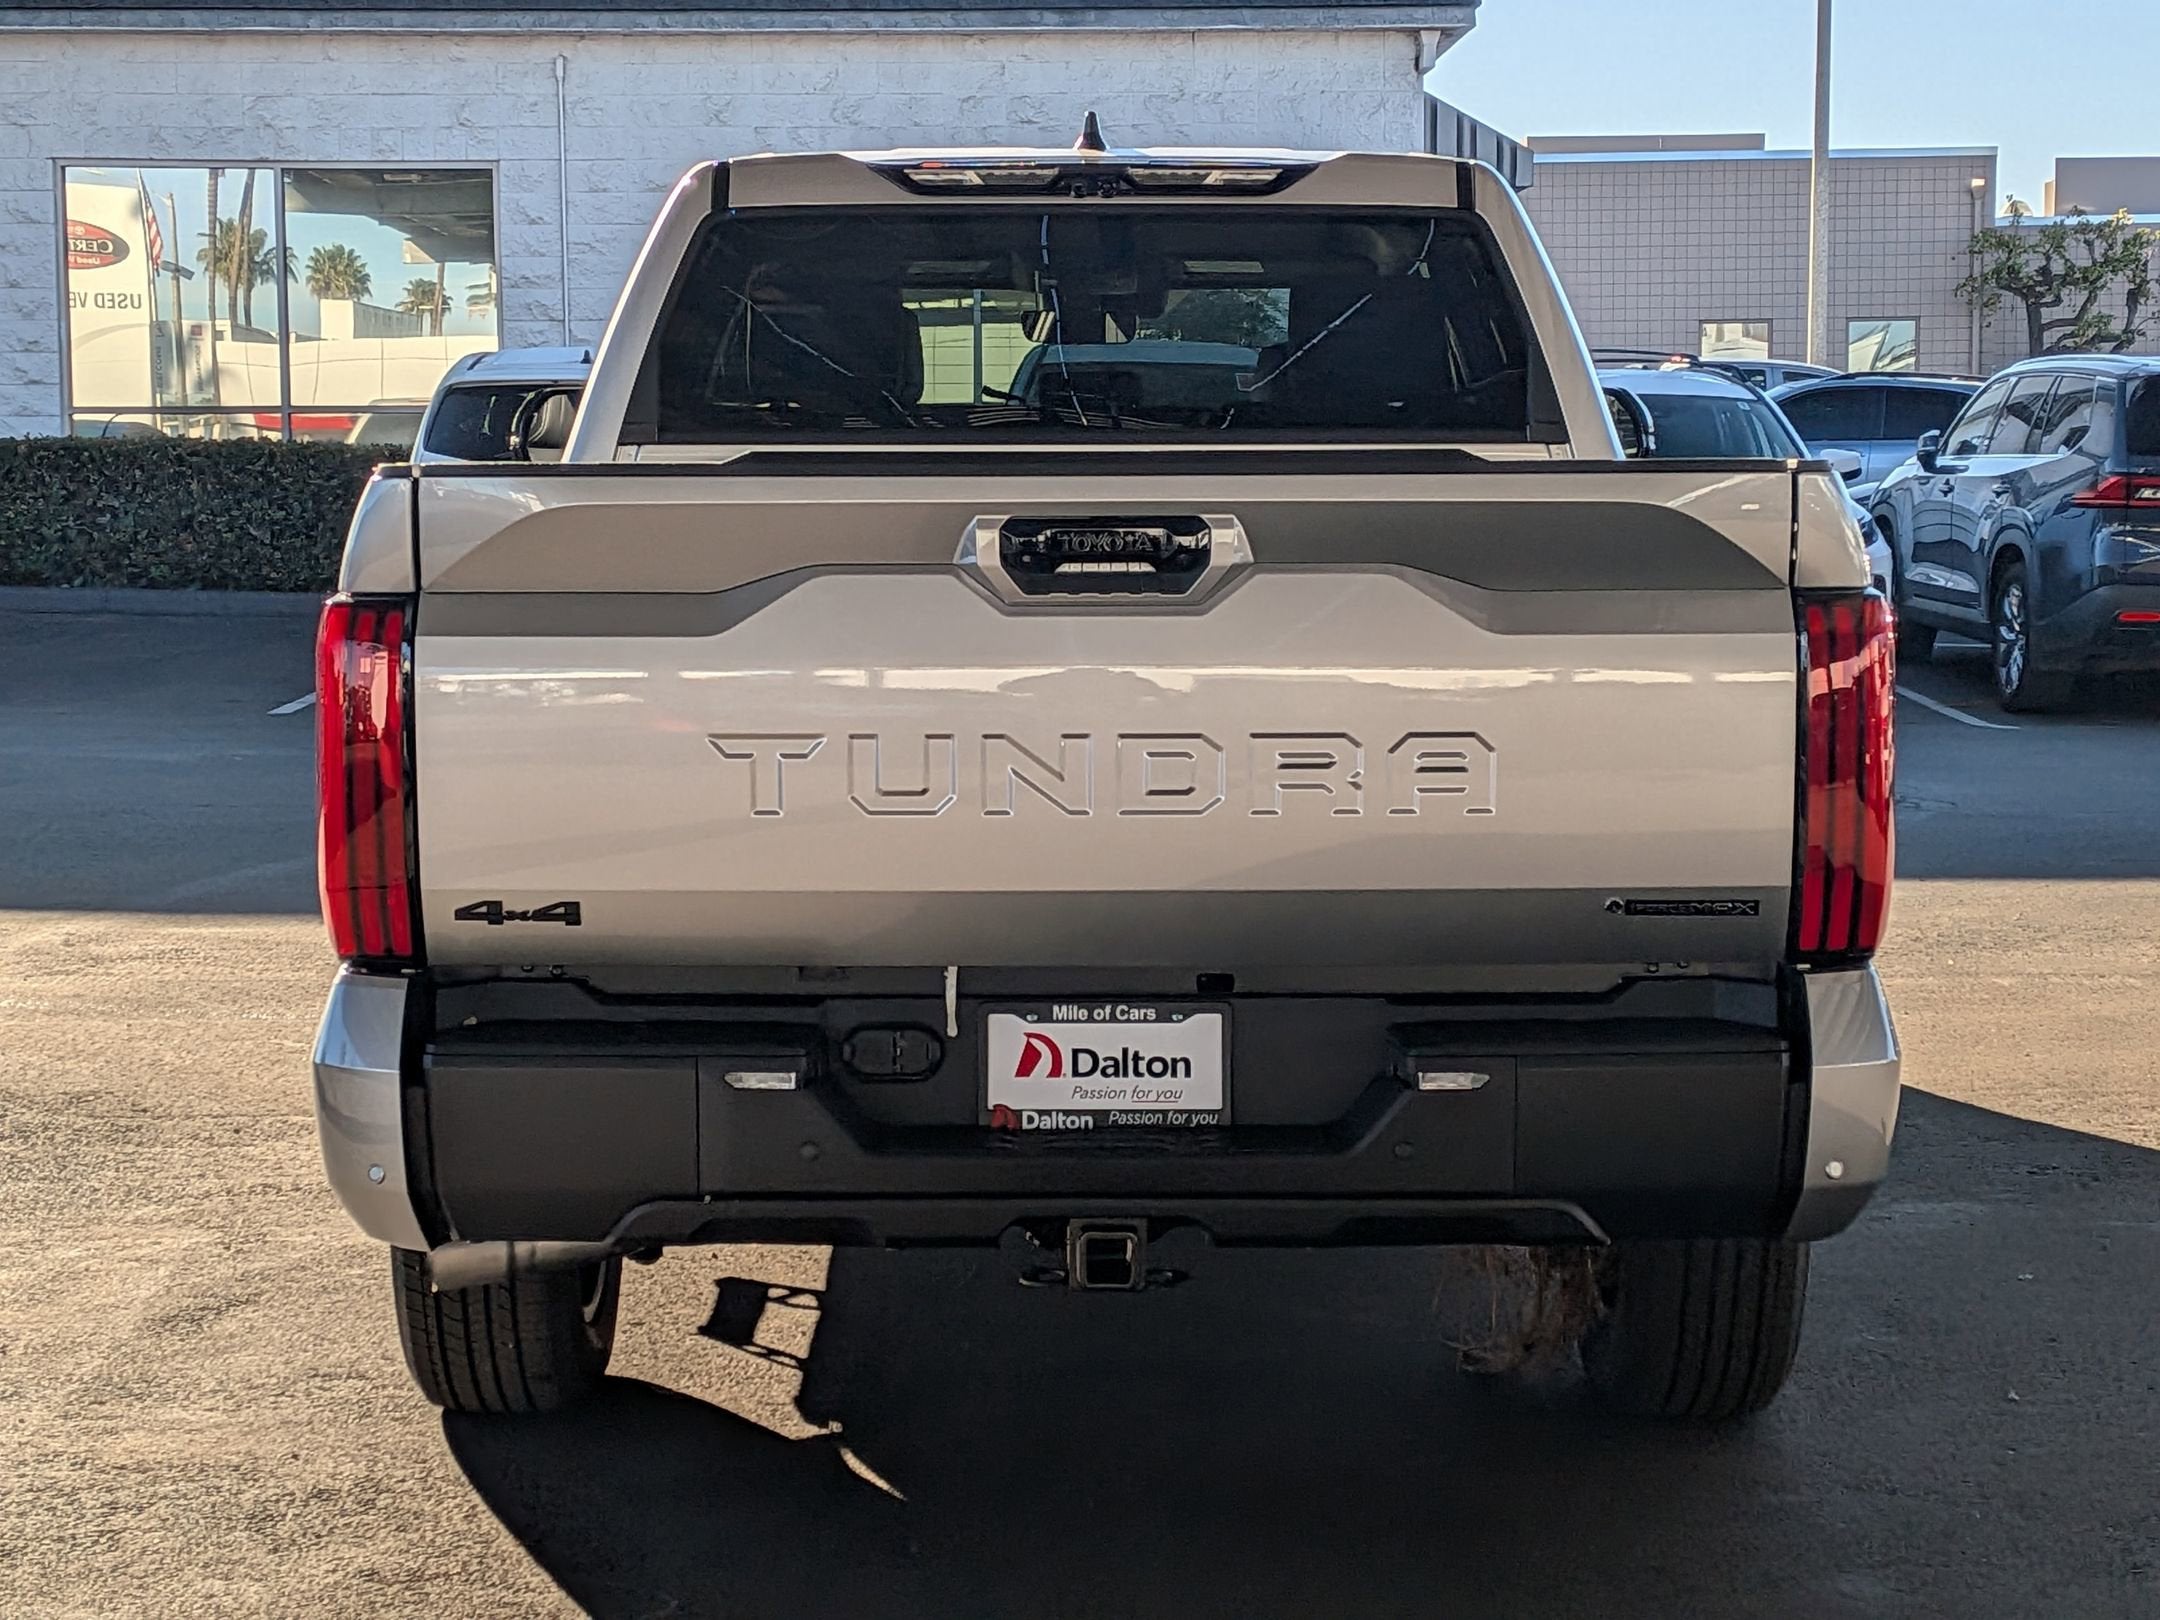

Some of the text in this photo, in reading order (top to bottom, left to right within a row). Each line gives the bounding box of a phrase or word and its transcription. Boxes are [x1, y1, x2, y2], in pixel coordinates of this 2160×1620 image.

[1057, 532, 1154, 552] TOYOTA
[706, 731, 1498, 817] TUNDRA
[1052, 1005, 1157, 1021] Mile of Cars
[1071, 1047, 1192, 1079] Dalton
[1071, 1085, 1184, 1102] Passion for you
[1022, 1111, 1219, 1130] Dalton Passion for you
